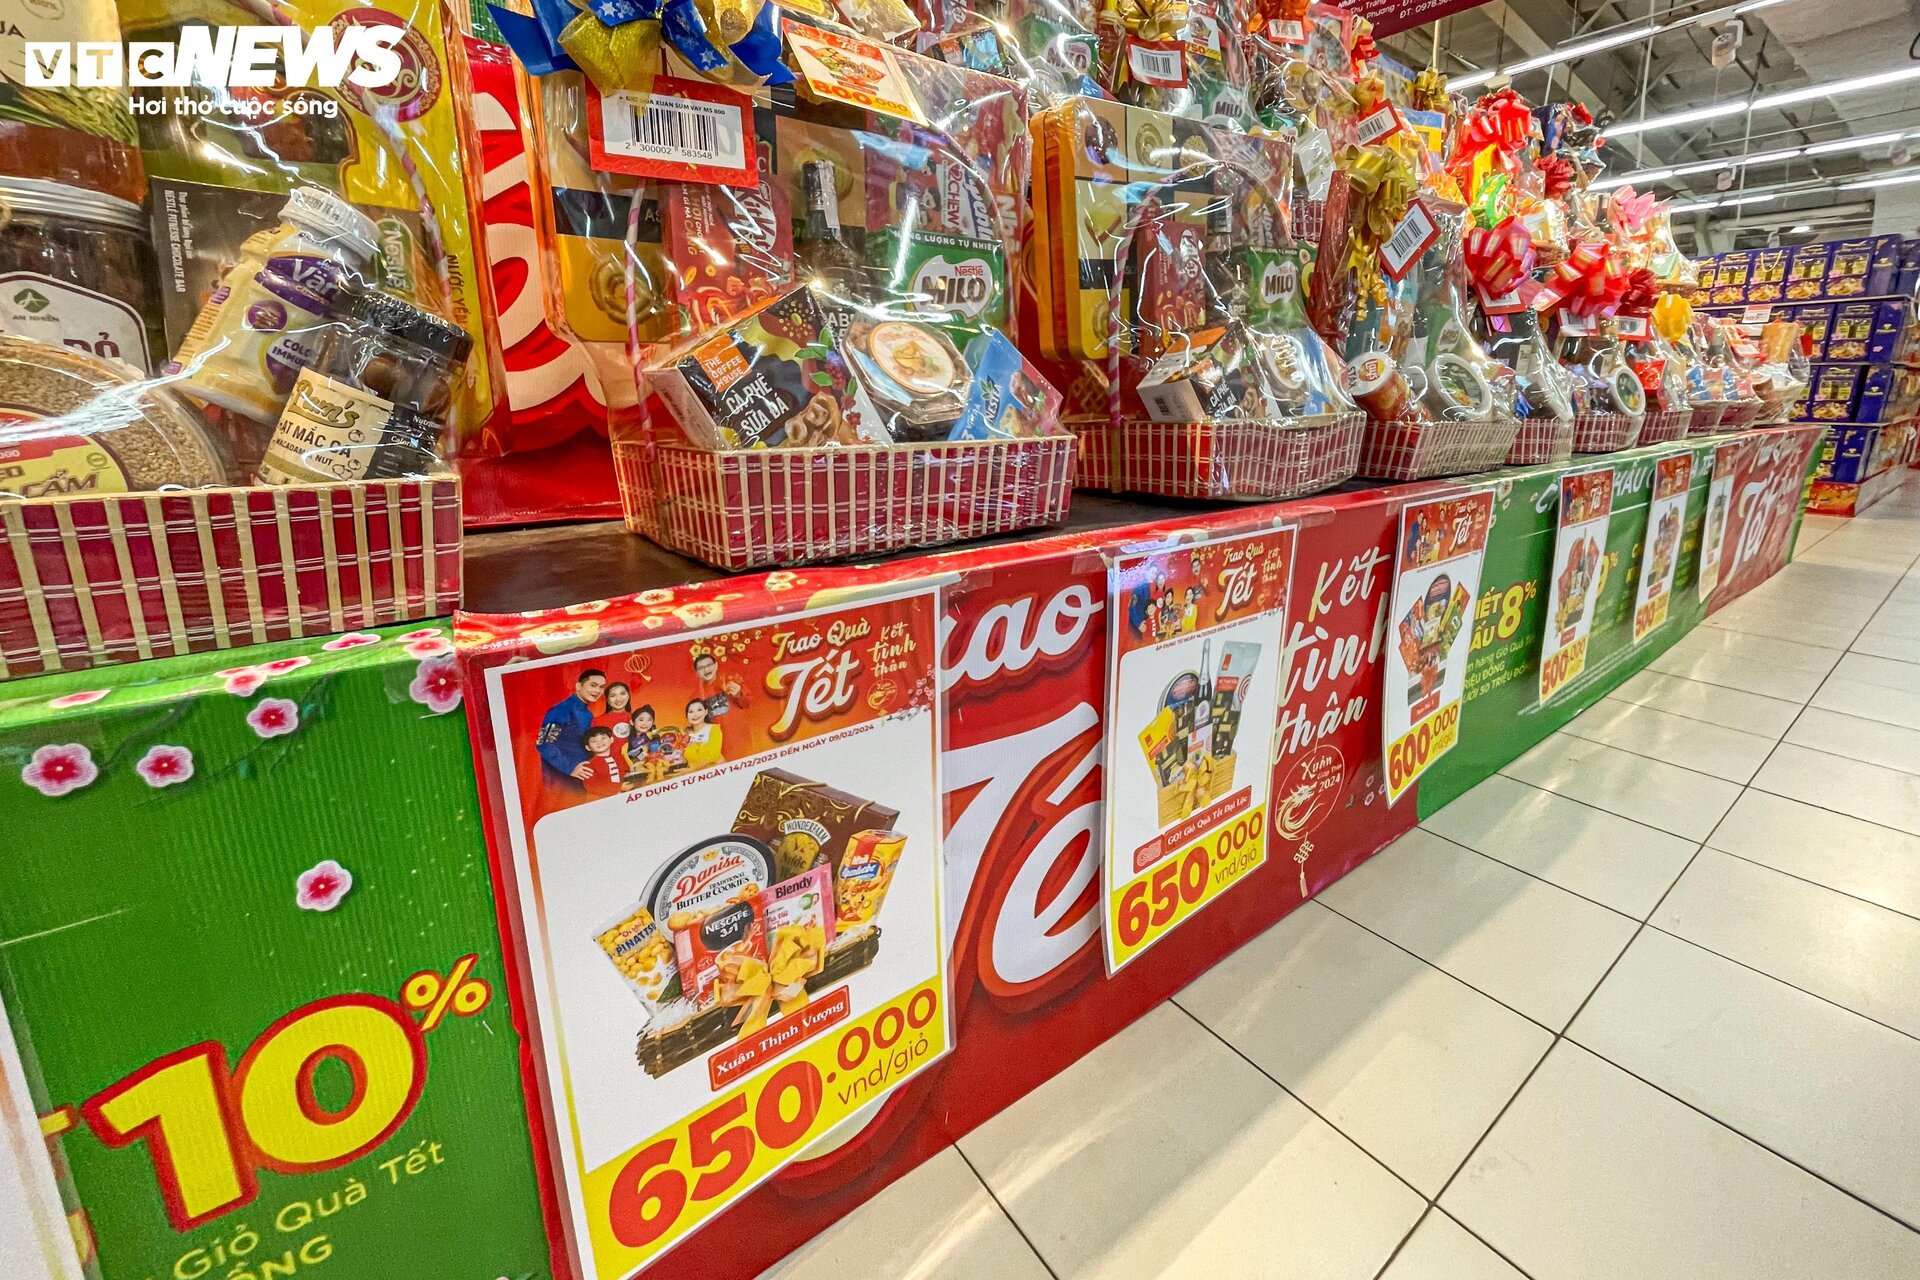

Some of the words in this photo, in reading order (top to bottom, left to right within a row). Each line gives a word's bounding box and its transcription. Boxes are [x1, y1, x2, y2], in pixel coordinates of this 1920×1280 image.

[1400, 8, 1414, 19] ĐT:
[655, 100, 674, 108] XUAN
[675, 102, 689, 110] SUM
[639, 143, 672, 155] 300002
[681, 149, 713, 159] 583548
[924, 234, 956, 245] LƯỢNG
[959, 239, 970, 248] TỰ
[920, 275, 986, 305] MILO
[1264, 273, 1293, 297] MILO
[704, 355, 723, 372] THE
[711, 355, 743, 379] COFFEE
[725, 389, 749, 415] CÀ
[742, 372, 773, 403] PHÊ
[985, 383, 1002, 424] NESTEA
[291, 425, 326, 449] MẮC
[740, 408, 772, 437] SỮA
[314, 453, 334, 467] NUT
[1222, 547, 1244, 567] Trao
[1216, 561, 1258, 616] Tết
[1308, 546, 1391, 623] Kết
[771, 631, 823, 663] Trao
[826, 617, 871, 647] Quà
[867, 633, 917, 664] tình
[880, 621, 909, 643] Kết
[870, 659, 908, 678] thân
[765, 649, 860, 739] Tết
[1271, 690, 1368, 766] thân
[1389, 703, 1459, 791] 600.000
[625, 791, 643, 804] ÁP
[645, 782, 680, 800] DỤNG
[681, 774, 696, 787] TỪ
[697, 767, 728, 783] NGÀY
[729, 752, 778, 773] 14/12/2023
[779, 743, 801, 758] ĐẾN
[802, 737, 828, 751] NGÀY
[828, 724, 875, 744] 09/02/2024
[1318, 772, 1341, 793] 2024
[785, 821, 829, 844] WONDERFARM
[671, 854, 743, 904] Danisa
[1117, 810, 1263, 949] 650.000
[1214, 843, 1258, 885] vnd/giỏ
[676, 890, 712, 911] BUTTER
[712, 876, 750, 897] COOKIES
[775, 876, 813, 899] Blendy
[716, 1048, 755, 1076] Xuân
[758, 1024, 799, 1054] Thịnh
[801, 1000, 845, 1029] Vượng
[837, 1031, 929, 1105] vnd/giỏ
[83, 954, 491, 1230] 10%
[608, 987, 937, 1248] 650.000
[172, 1222, 260, 1280] Giỏ
[275, 1177, 369, 1233] Quà
[378, 1139, 446, 1186] Tết
